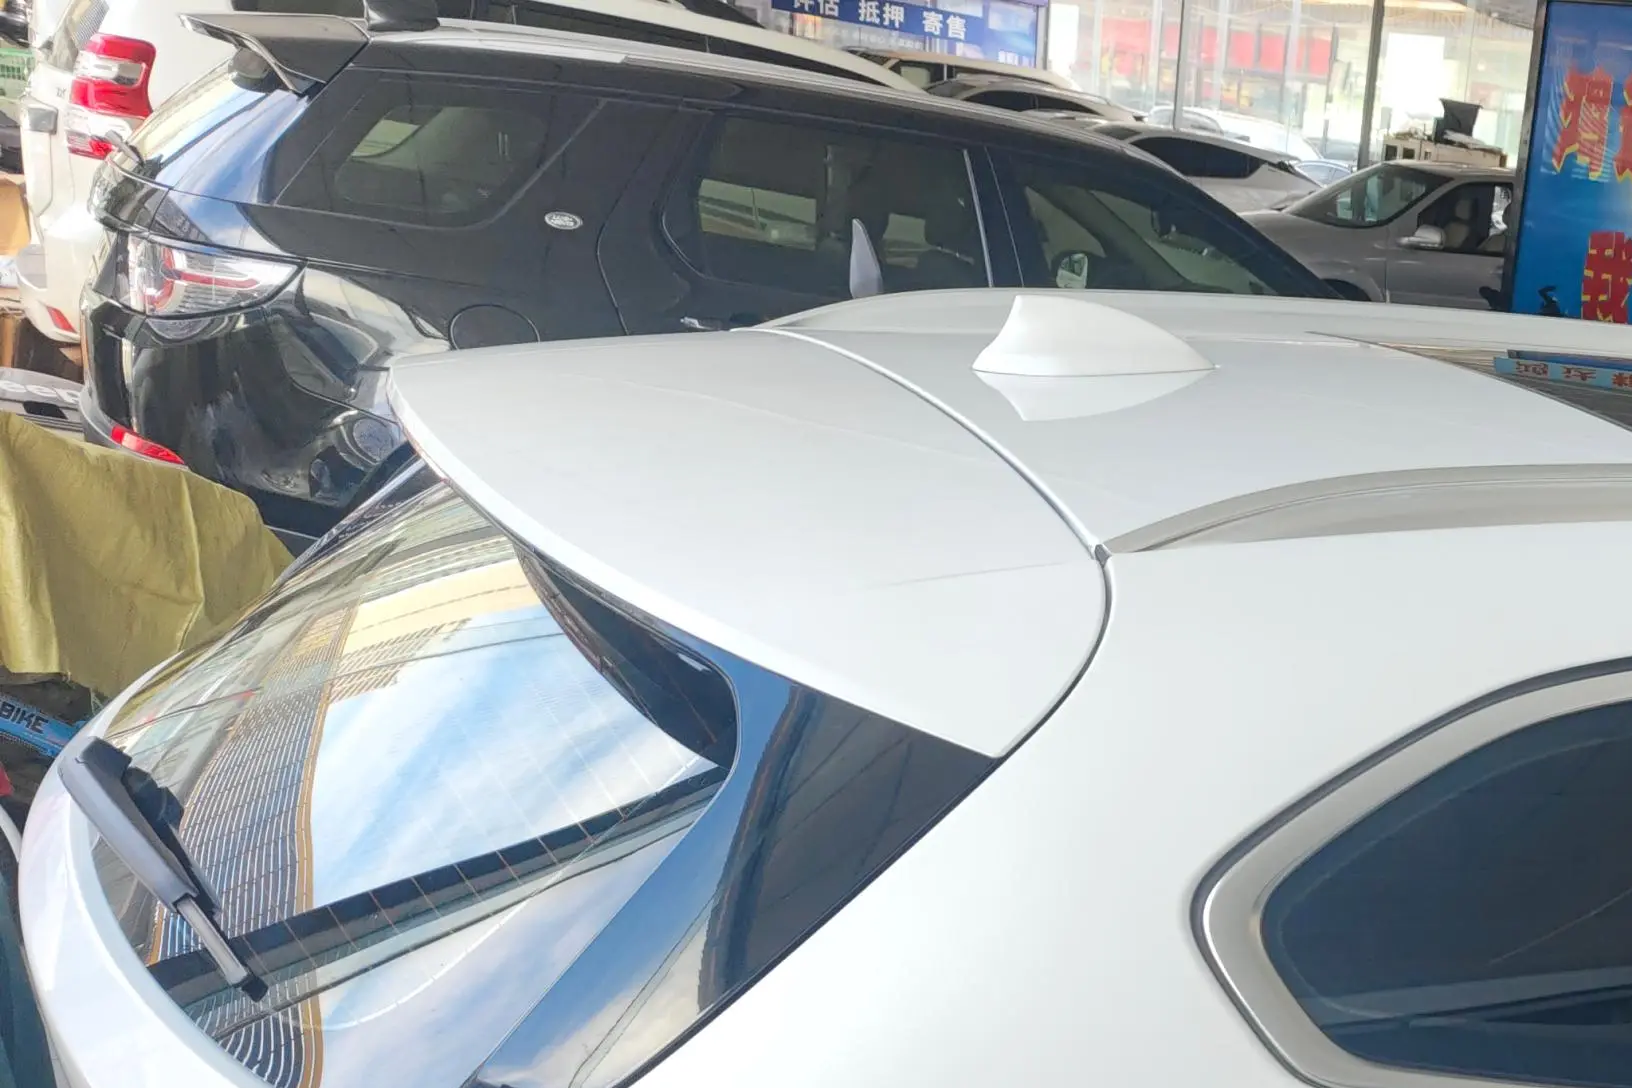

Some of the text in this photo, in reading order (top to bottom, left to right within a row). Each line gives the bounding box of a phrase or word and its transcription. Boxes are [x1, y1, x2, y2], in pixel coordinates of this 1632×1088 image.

[858, 0, 904, 28] 抵押
[923, 10, 966, 40] 寄售
[0, 700, 49, 734] BIKE
